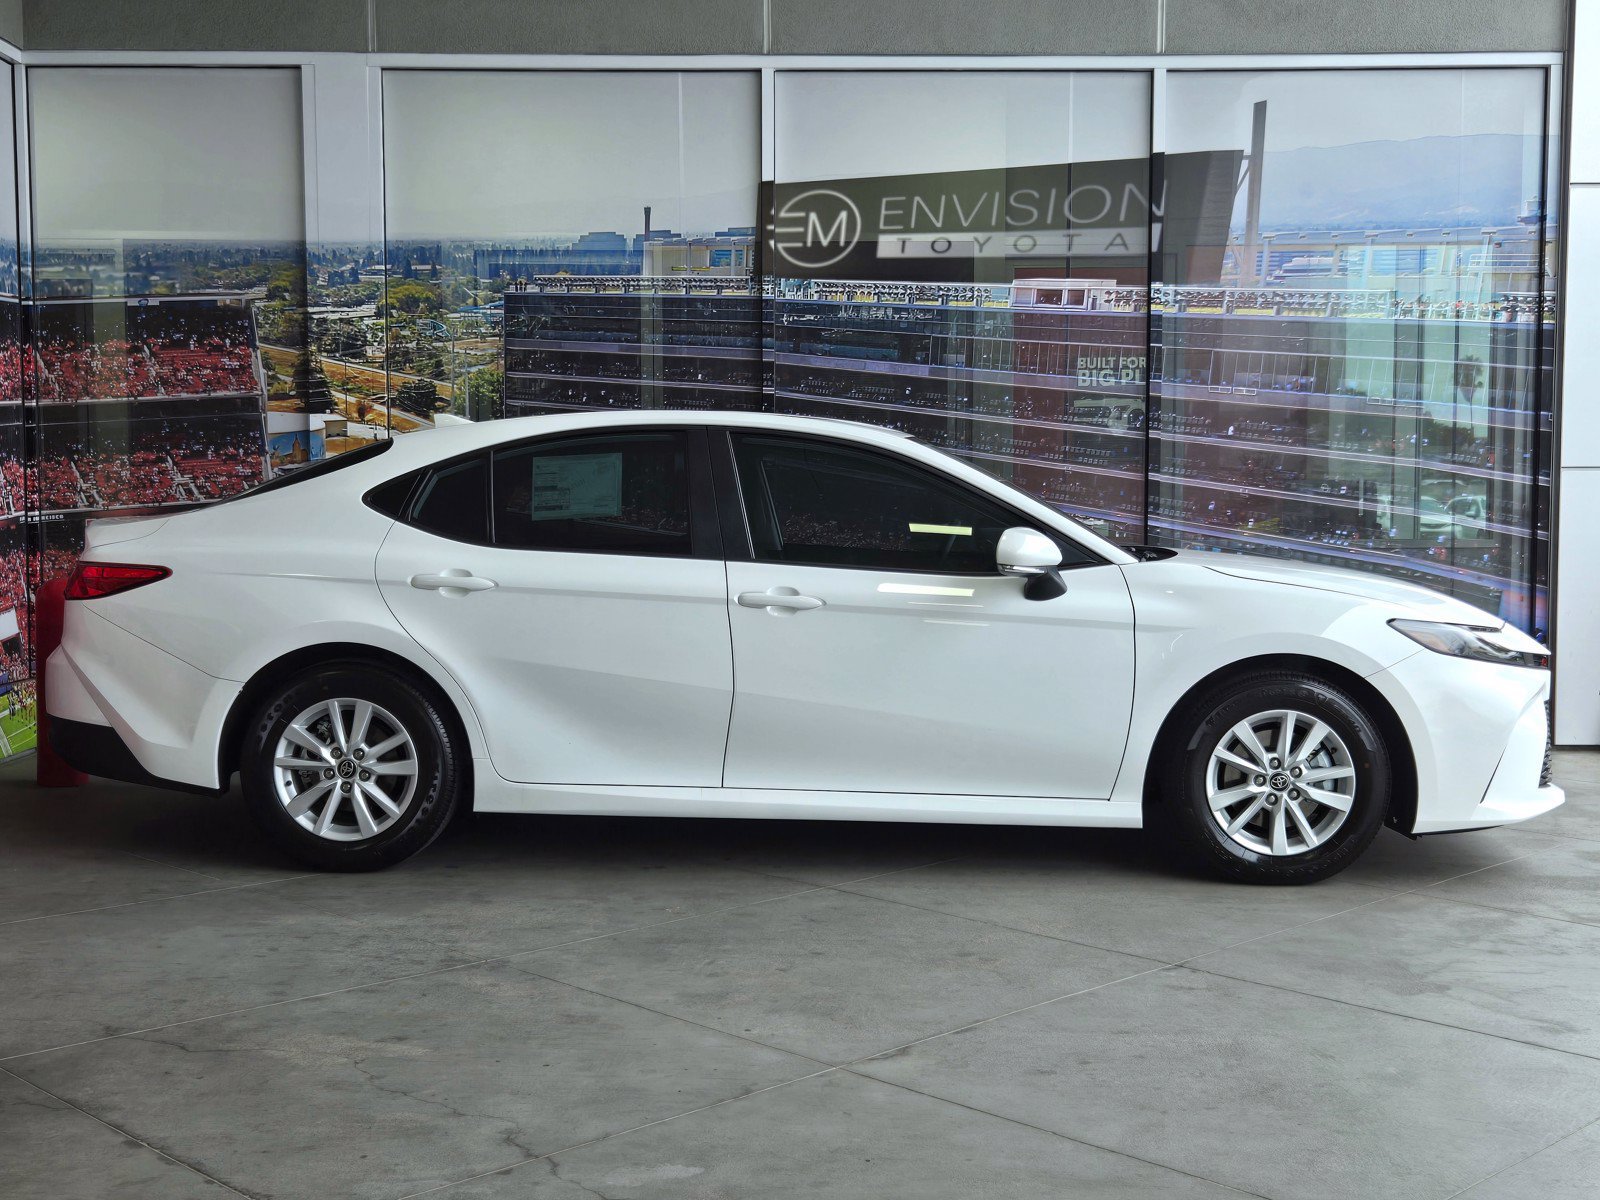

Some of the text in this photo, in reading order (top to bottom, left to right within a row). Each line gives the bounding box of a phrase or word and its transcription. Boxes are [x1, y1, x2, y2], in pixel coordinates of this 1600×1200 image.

[878, 180, 1168, 231] ENVISION
[898, 232, 1129, 255] TOYOTA
[1078, 356, 1146, 369] BUILT FOR
[1078, 369, 1115, 387] BIG
